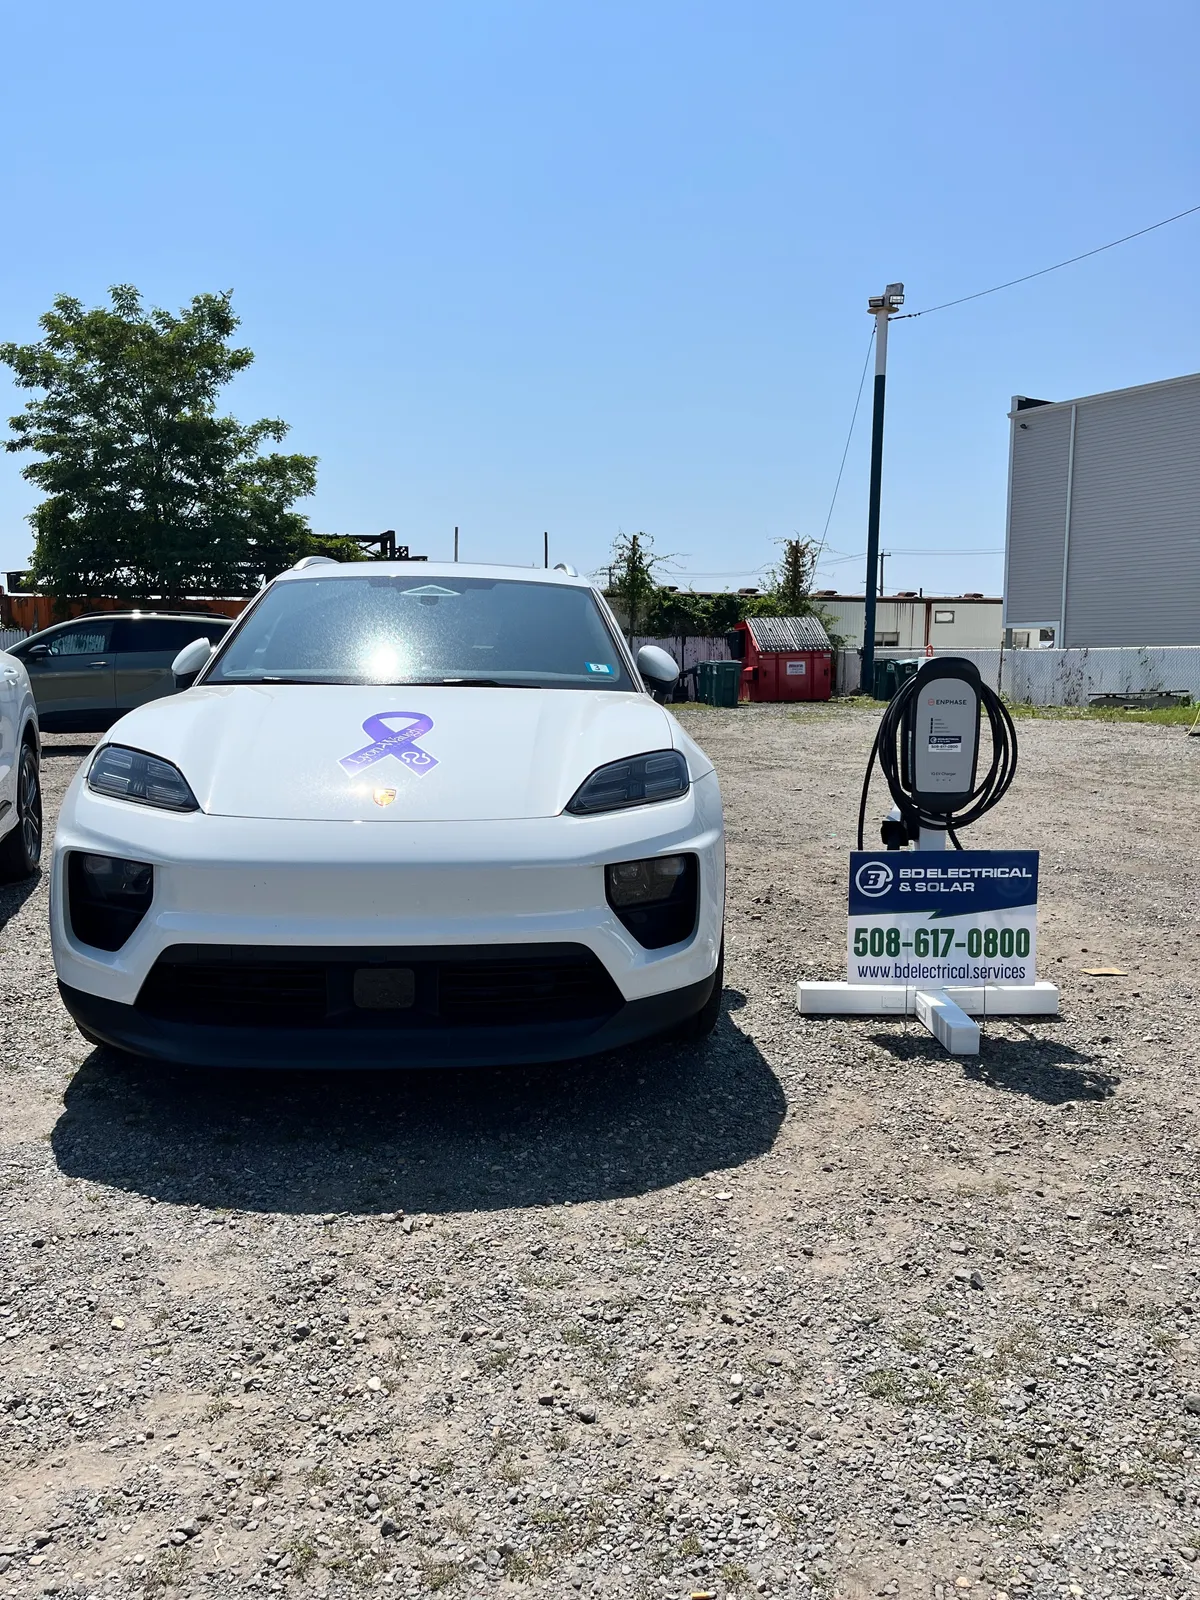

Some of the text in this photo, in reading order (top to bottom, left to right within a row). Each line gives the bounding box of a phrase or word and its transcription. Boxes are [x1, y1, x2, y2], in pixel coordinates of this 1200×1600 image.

[898, 882, 975, 893] & SOLAR
[853, 927, 1031, 959] 508-617-0800
[857, 962, 1026, 980] www.bdelectrical.services
